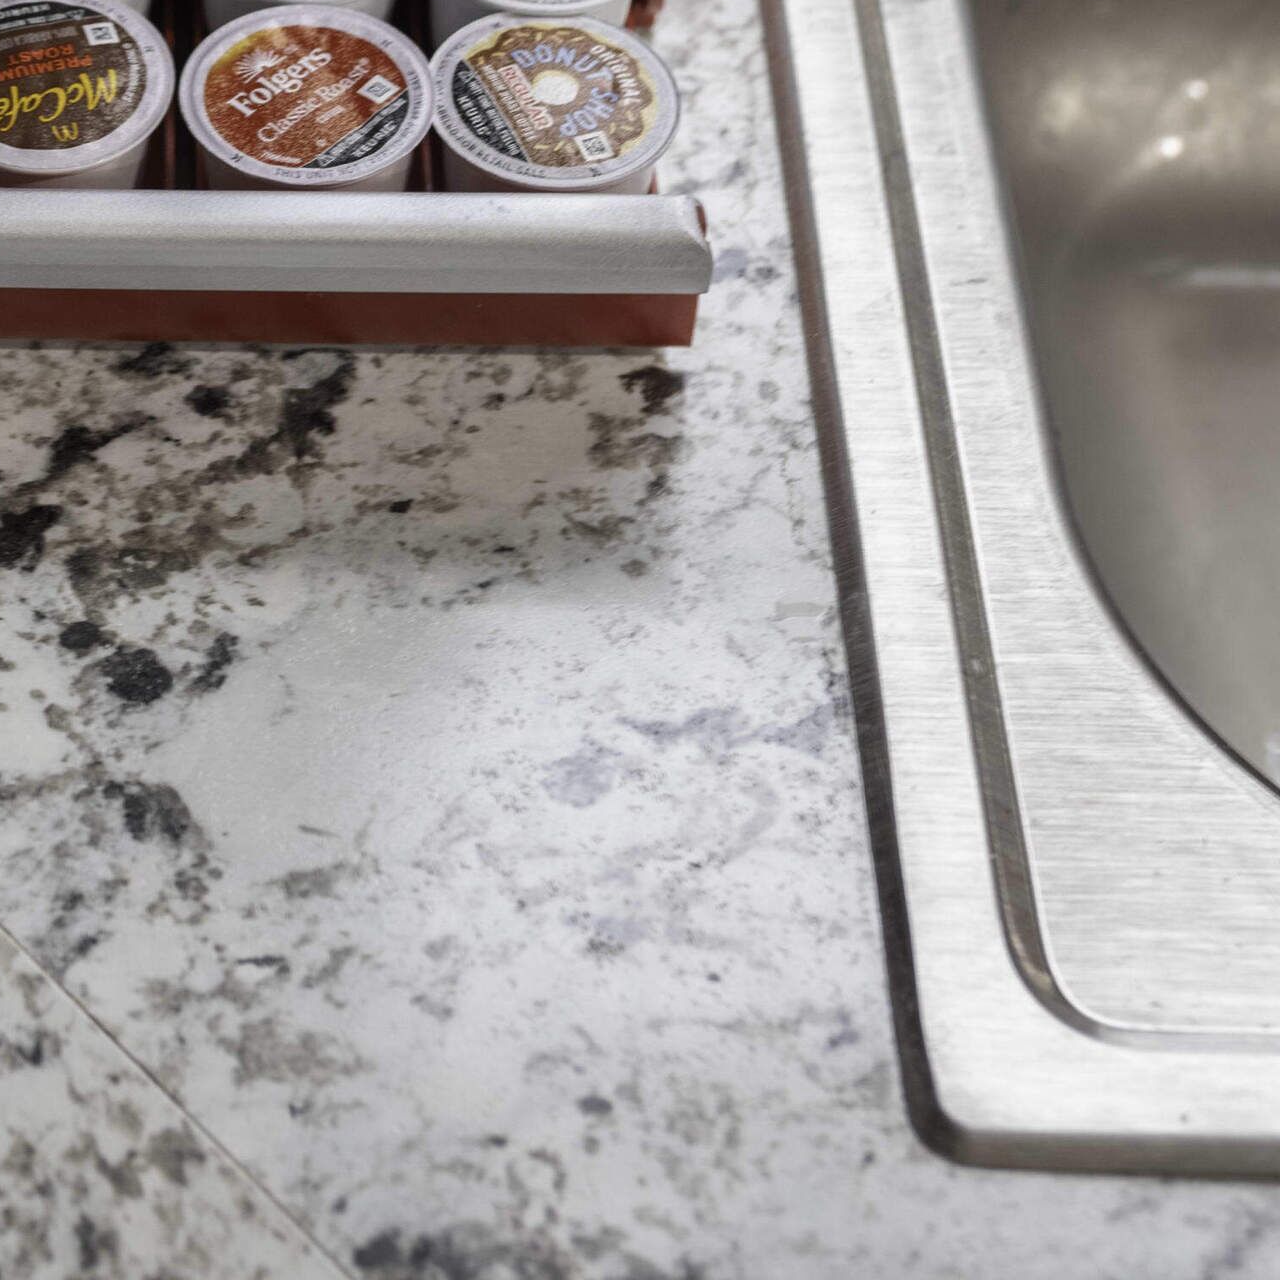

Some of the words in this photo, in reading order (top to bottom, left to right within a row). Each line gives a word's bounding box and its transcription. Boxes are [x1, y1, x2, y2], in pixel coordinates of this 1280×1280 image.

[4, 42, 75, 66] ROAST
[513, 44, 613, 78] DONUT
[589, 45, 636, 104] ORIGINAL
[225, 46, 334, 117] Folgers
[501, 67, 551, 127] REGULAR
[257, 97, 321, 141] Classic
[455, 94, 490, 135] KEURIG
[561, 87, 615, 135] SHOP
[350, 120, 396, 158] KEURIG
